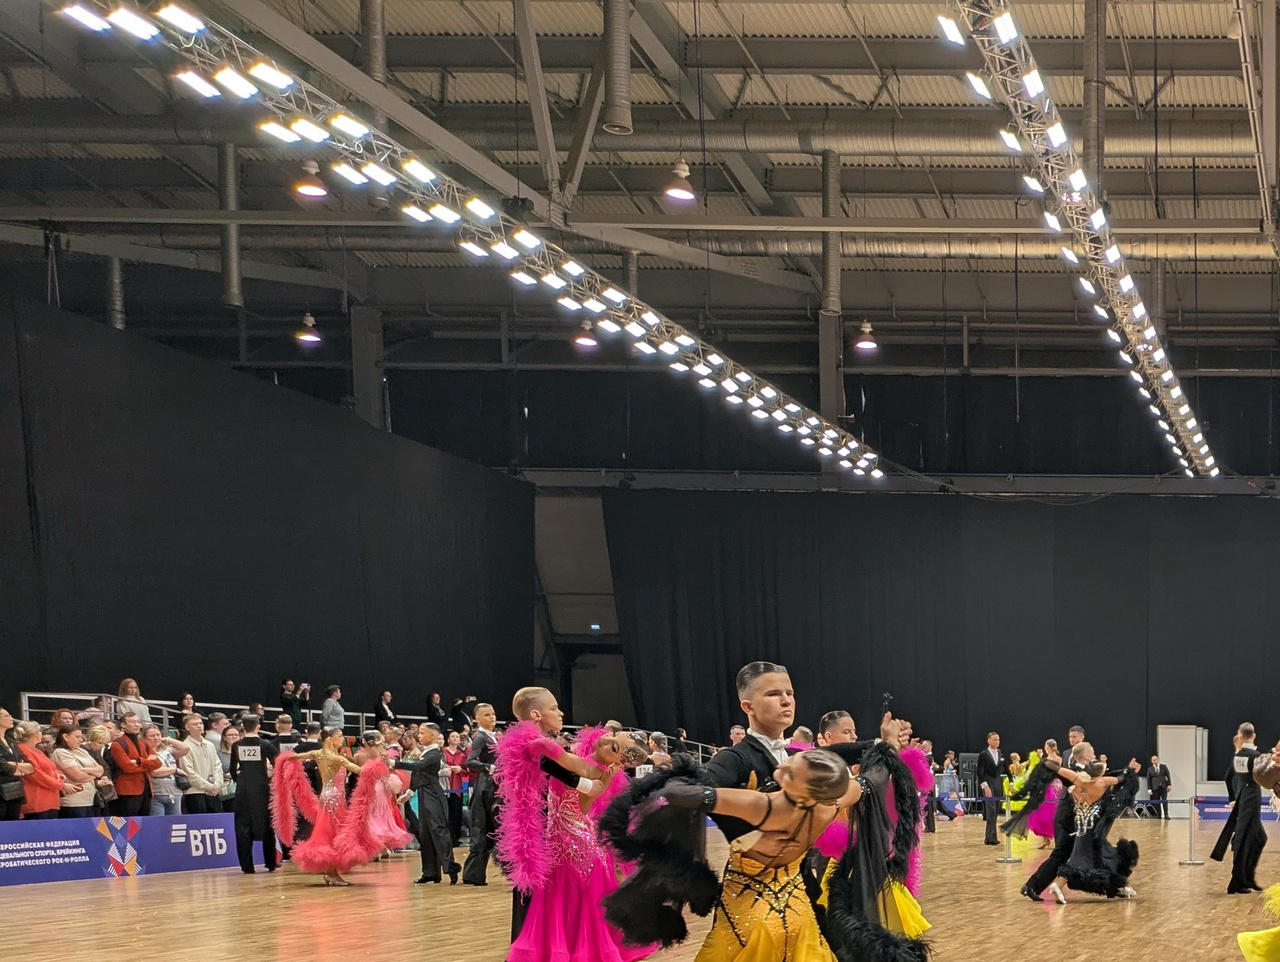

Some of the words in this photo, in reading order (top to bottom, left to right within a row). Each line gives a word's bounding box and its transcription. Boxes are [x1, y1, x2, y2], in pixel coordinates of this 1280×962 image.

[242, 748, 257, 757] 122
[46, 839, 80, 848] ФЕДЕРАЦИЯ
[189, 828, 228, 857] ВТБ
[35, 849, 57, 857] СПОРТА,
[57, 847, 86, 856] БРЕЙКИНГА
[52, 855, 90, 865] РОК-Н-РОЛЛА
